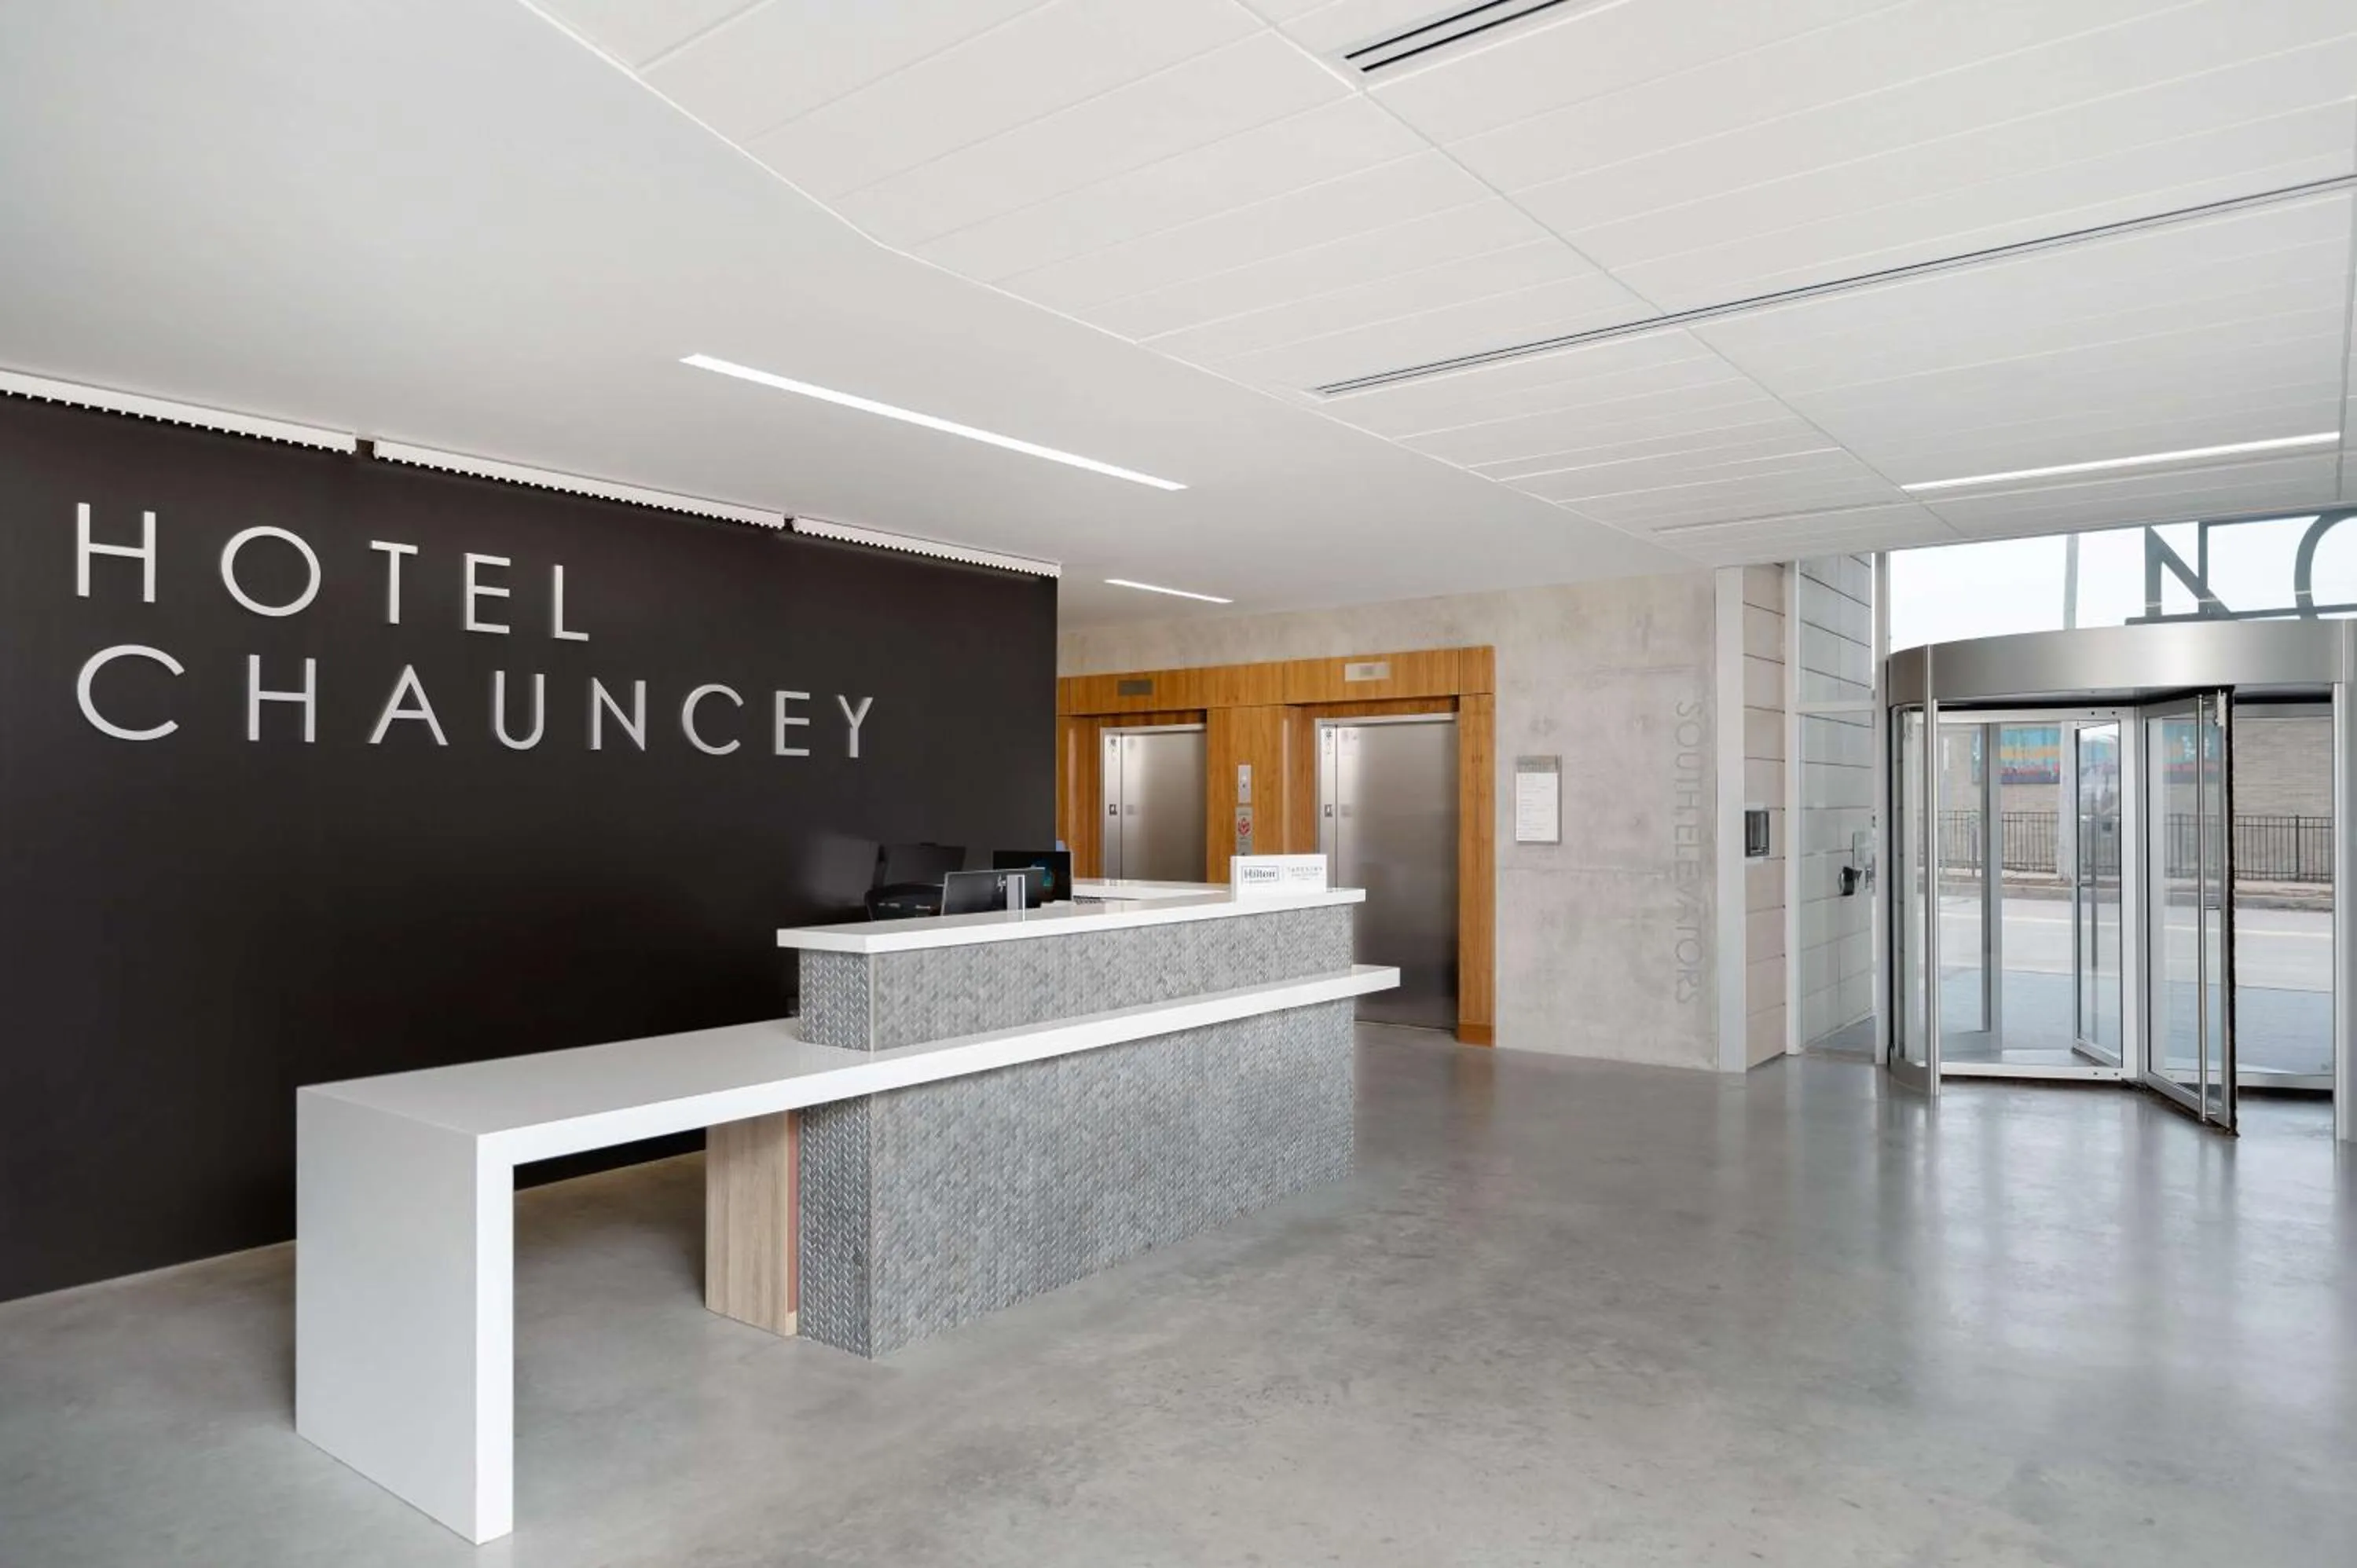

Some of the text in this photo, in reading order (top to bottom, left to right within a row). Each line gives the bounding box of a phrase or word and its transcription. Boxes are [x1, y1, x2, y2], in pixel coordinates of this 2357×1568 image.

[76, 502, 589, 642] HOTEL
[77, 644, 874, 758] CHAUNCEY
[1244, 869, 1275, 879] Hilton
[1674, 700, 1703, 1005] SOUTH ELEVATORS
